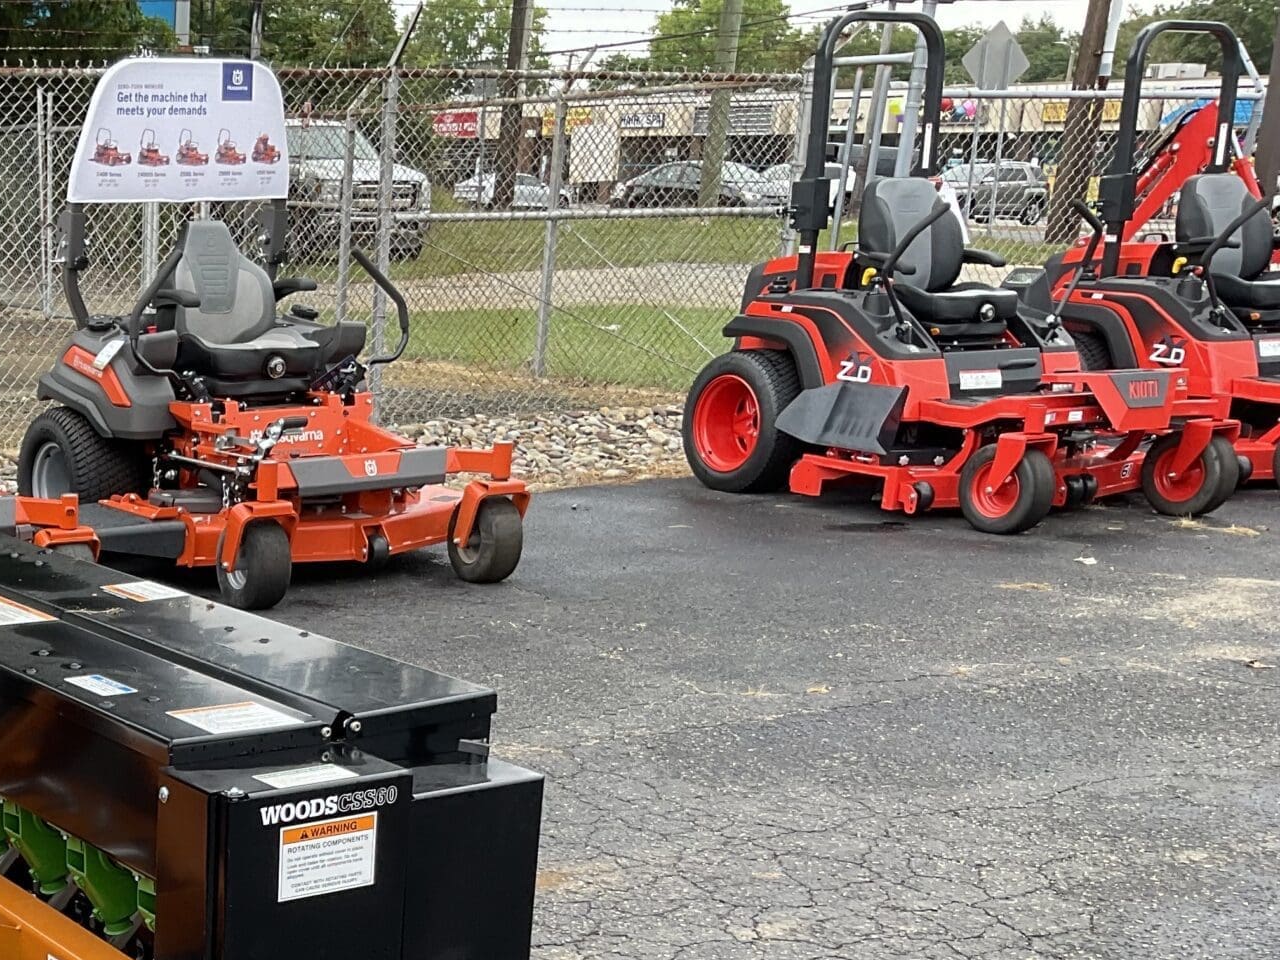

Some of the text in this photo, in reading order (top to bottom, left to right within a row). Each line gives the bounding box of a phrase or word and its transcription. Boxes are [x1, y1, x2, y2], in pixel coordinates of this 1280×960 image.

[116, 91, 208, 103] Get the machine that
[116, 104, 208, 119] meets your demands
[1128, 379, 1159, 400] KIOTI
[260, 785, 398, 826] WOODS CSS60
[310, 821, 358, 837] WARNING
[287, 834, 369, 854] ROTATING COMPONENTS
